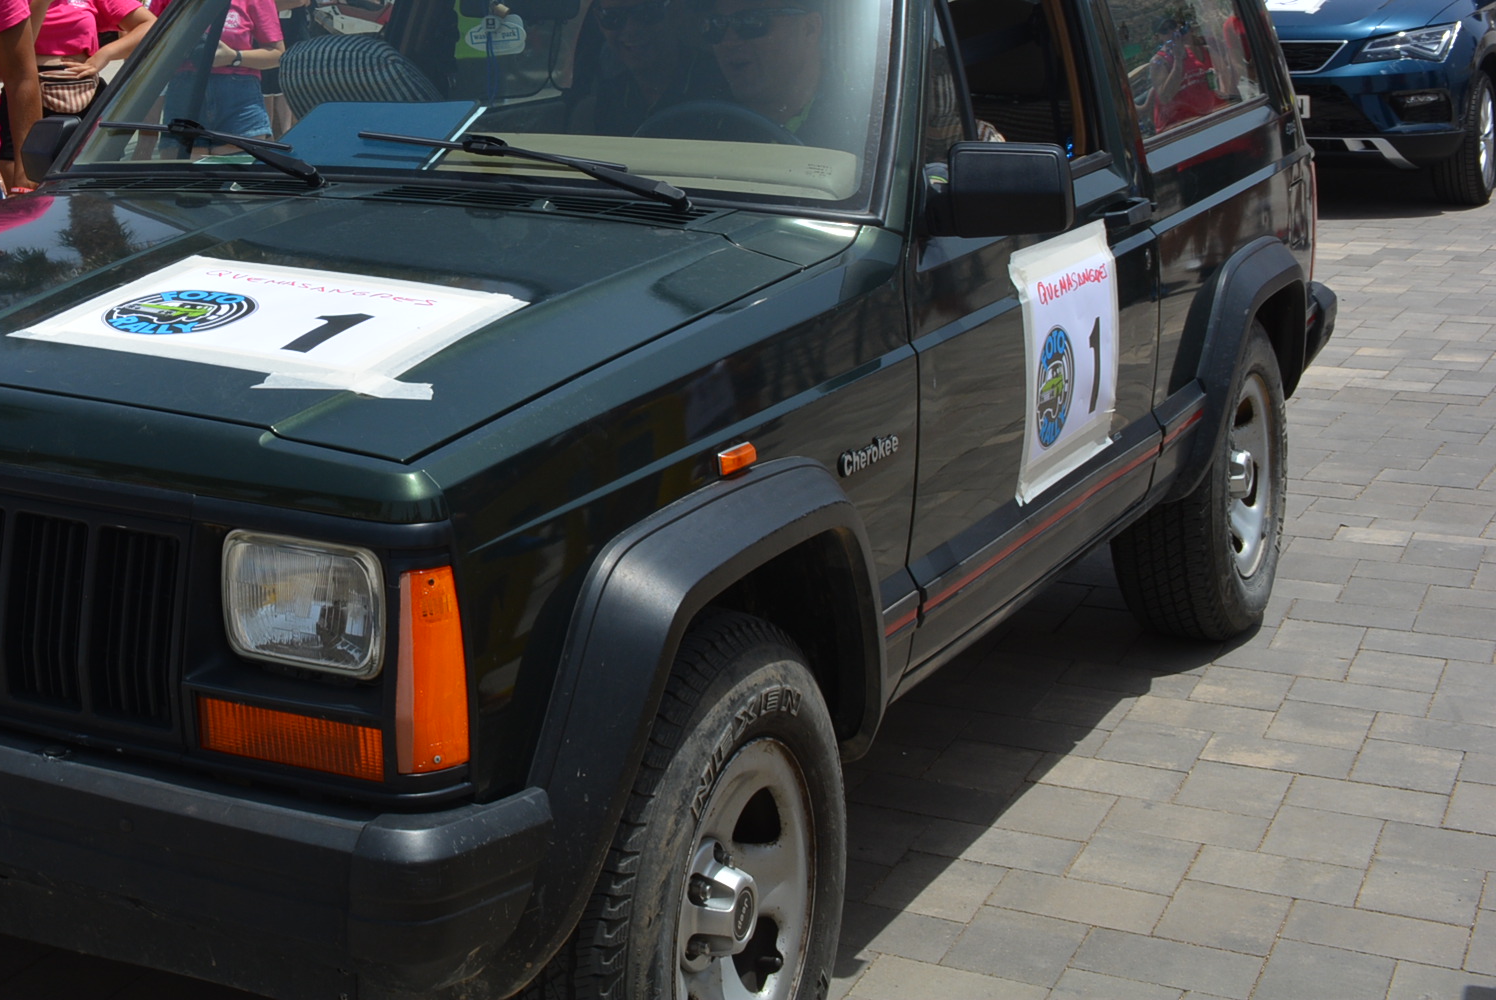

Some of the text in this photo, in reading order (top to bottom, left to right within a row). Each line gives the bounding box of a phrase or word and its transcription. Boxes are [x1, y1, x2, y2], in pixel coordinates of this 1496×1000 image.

[160, 290, 244, 305] FOTO
[108, 316, 198, 333] RALLY
[280, 313, 375, 353] 1
[1041, 330, 1066, 370] FOTO
[1088, 316, 1100, 414] 1
[1040, 404, 1066, 445] RALLY
[842, 435, 899, 477] Cherokee
[737, 897, 749, 930] Jeep
